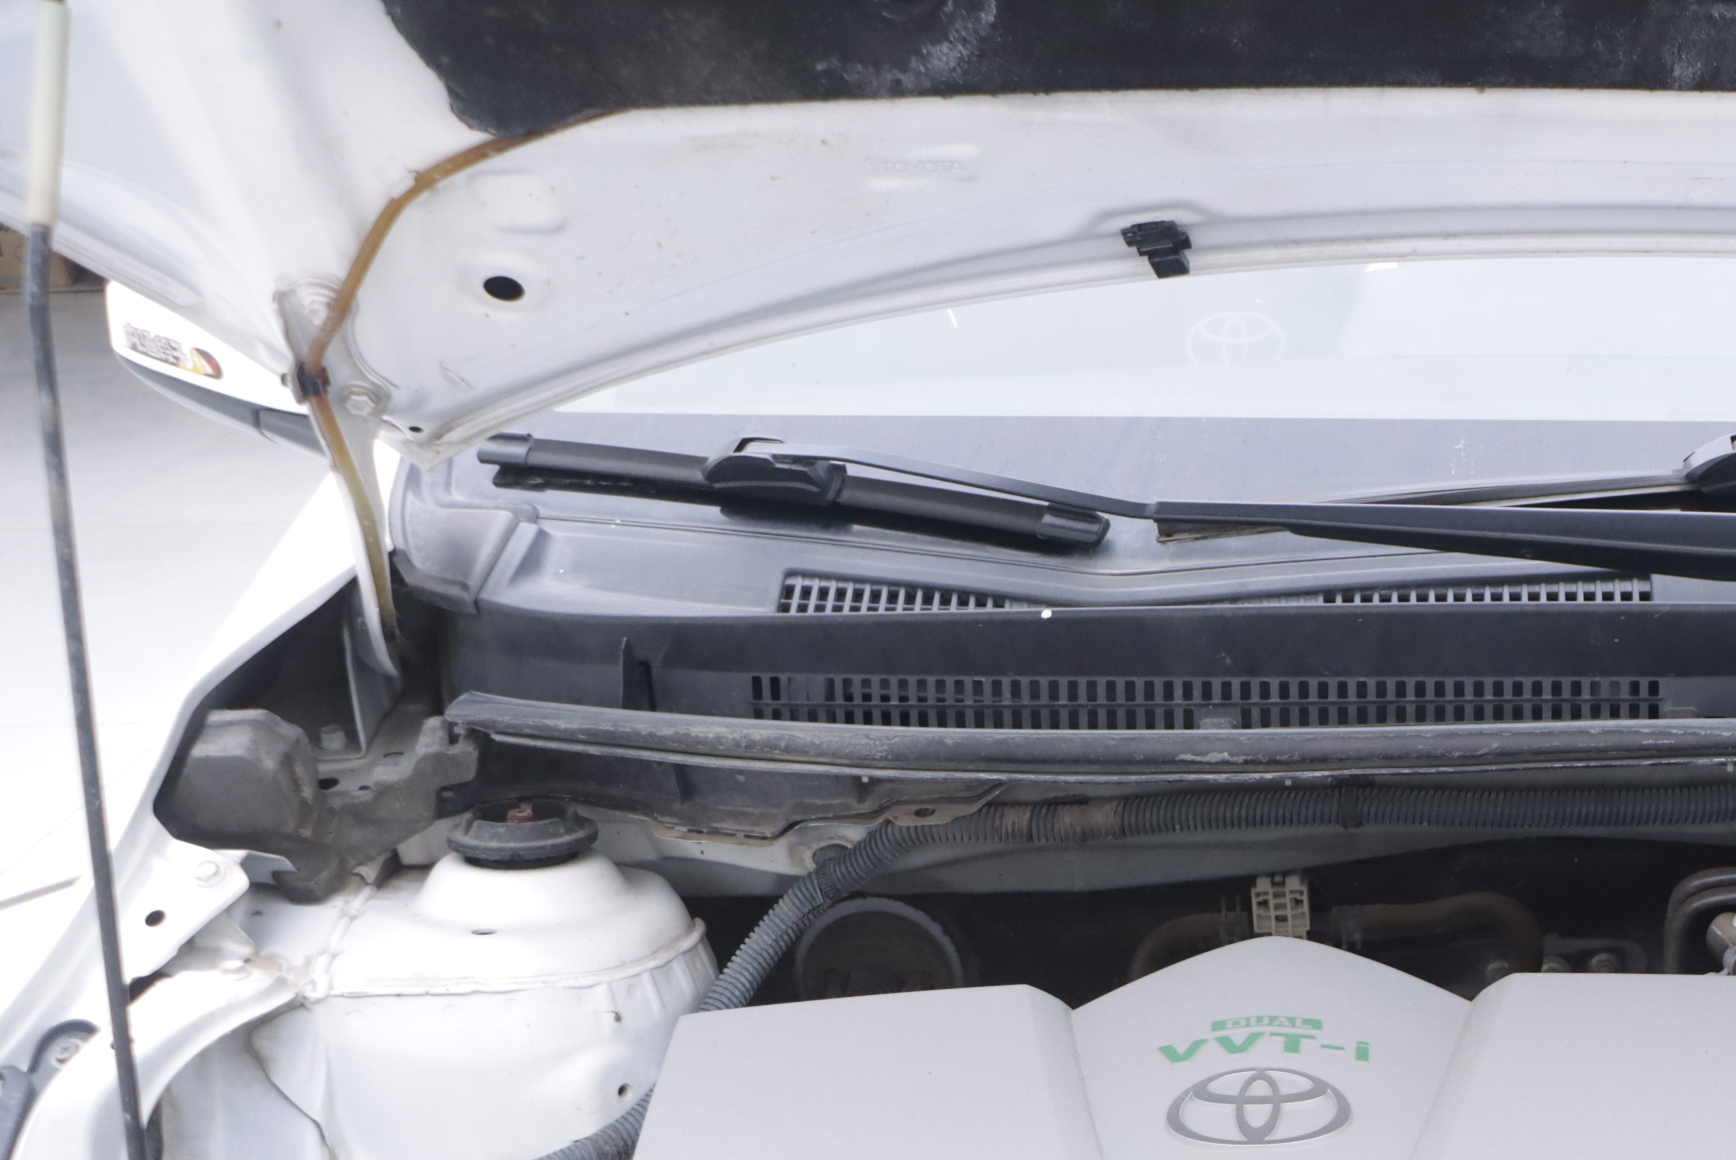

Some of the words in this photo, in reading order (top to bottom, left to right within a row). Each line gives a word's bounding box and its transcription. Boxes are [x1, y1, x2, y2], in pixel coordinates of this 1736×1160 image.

[879, 158, 967, 174] TOYOTA
[1225, 1016, 1314, 1030] DUAL
[1157, 1031, 1371, 1063] VVT-i
